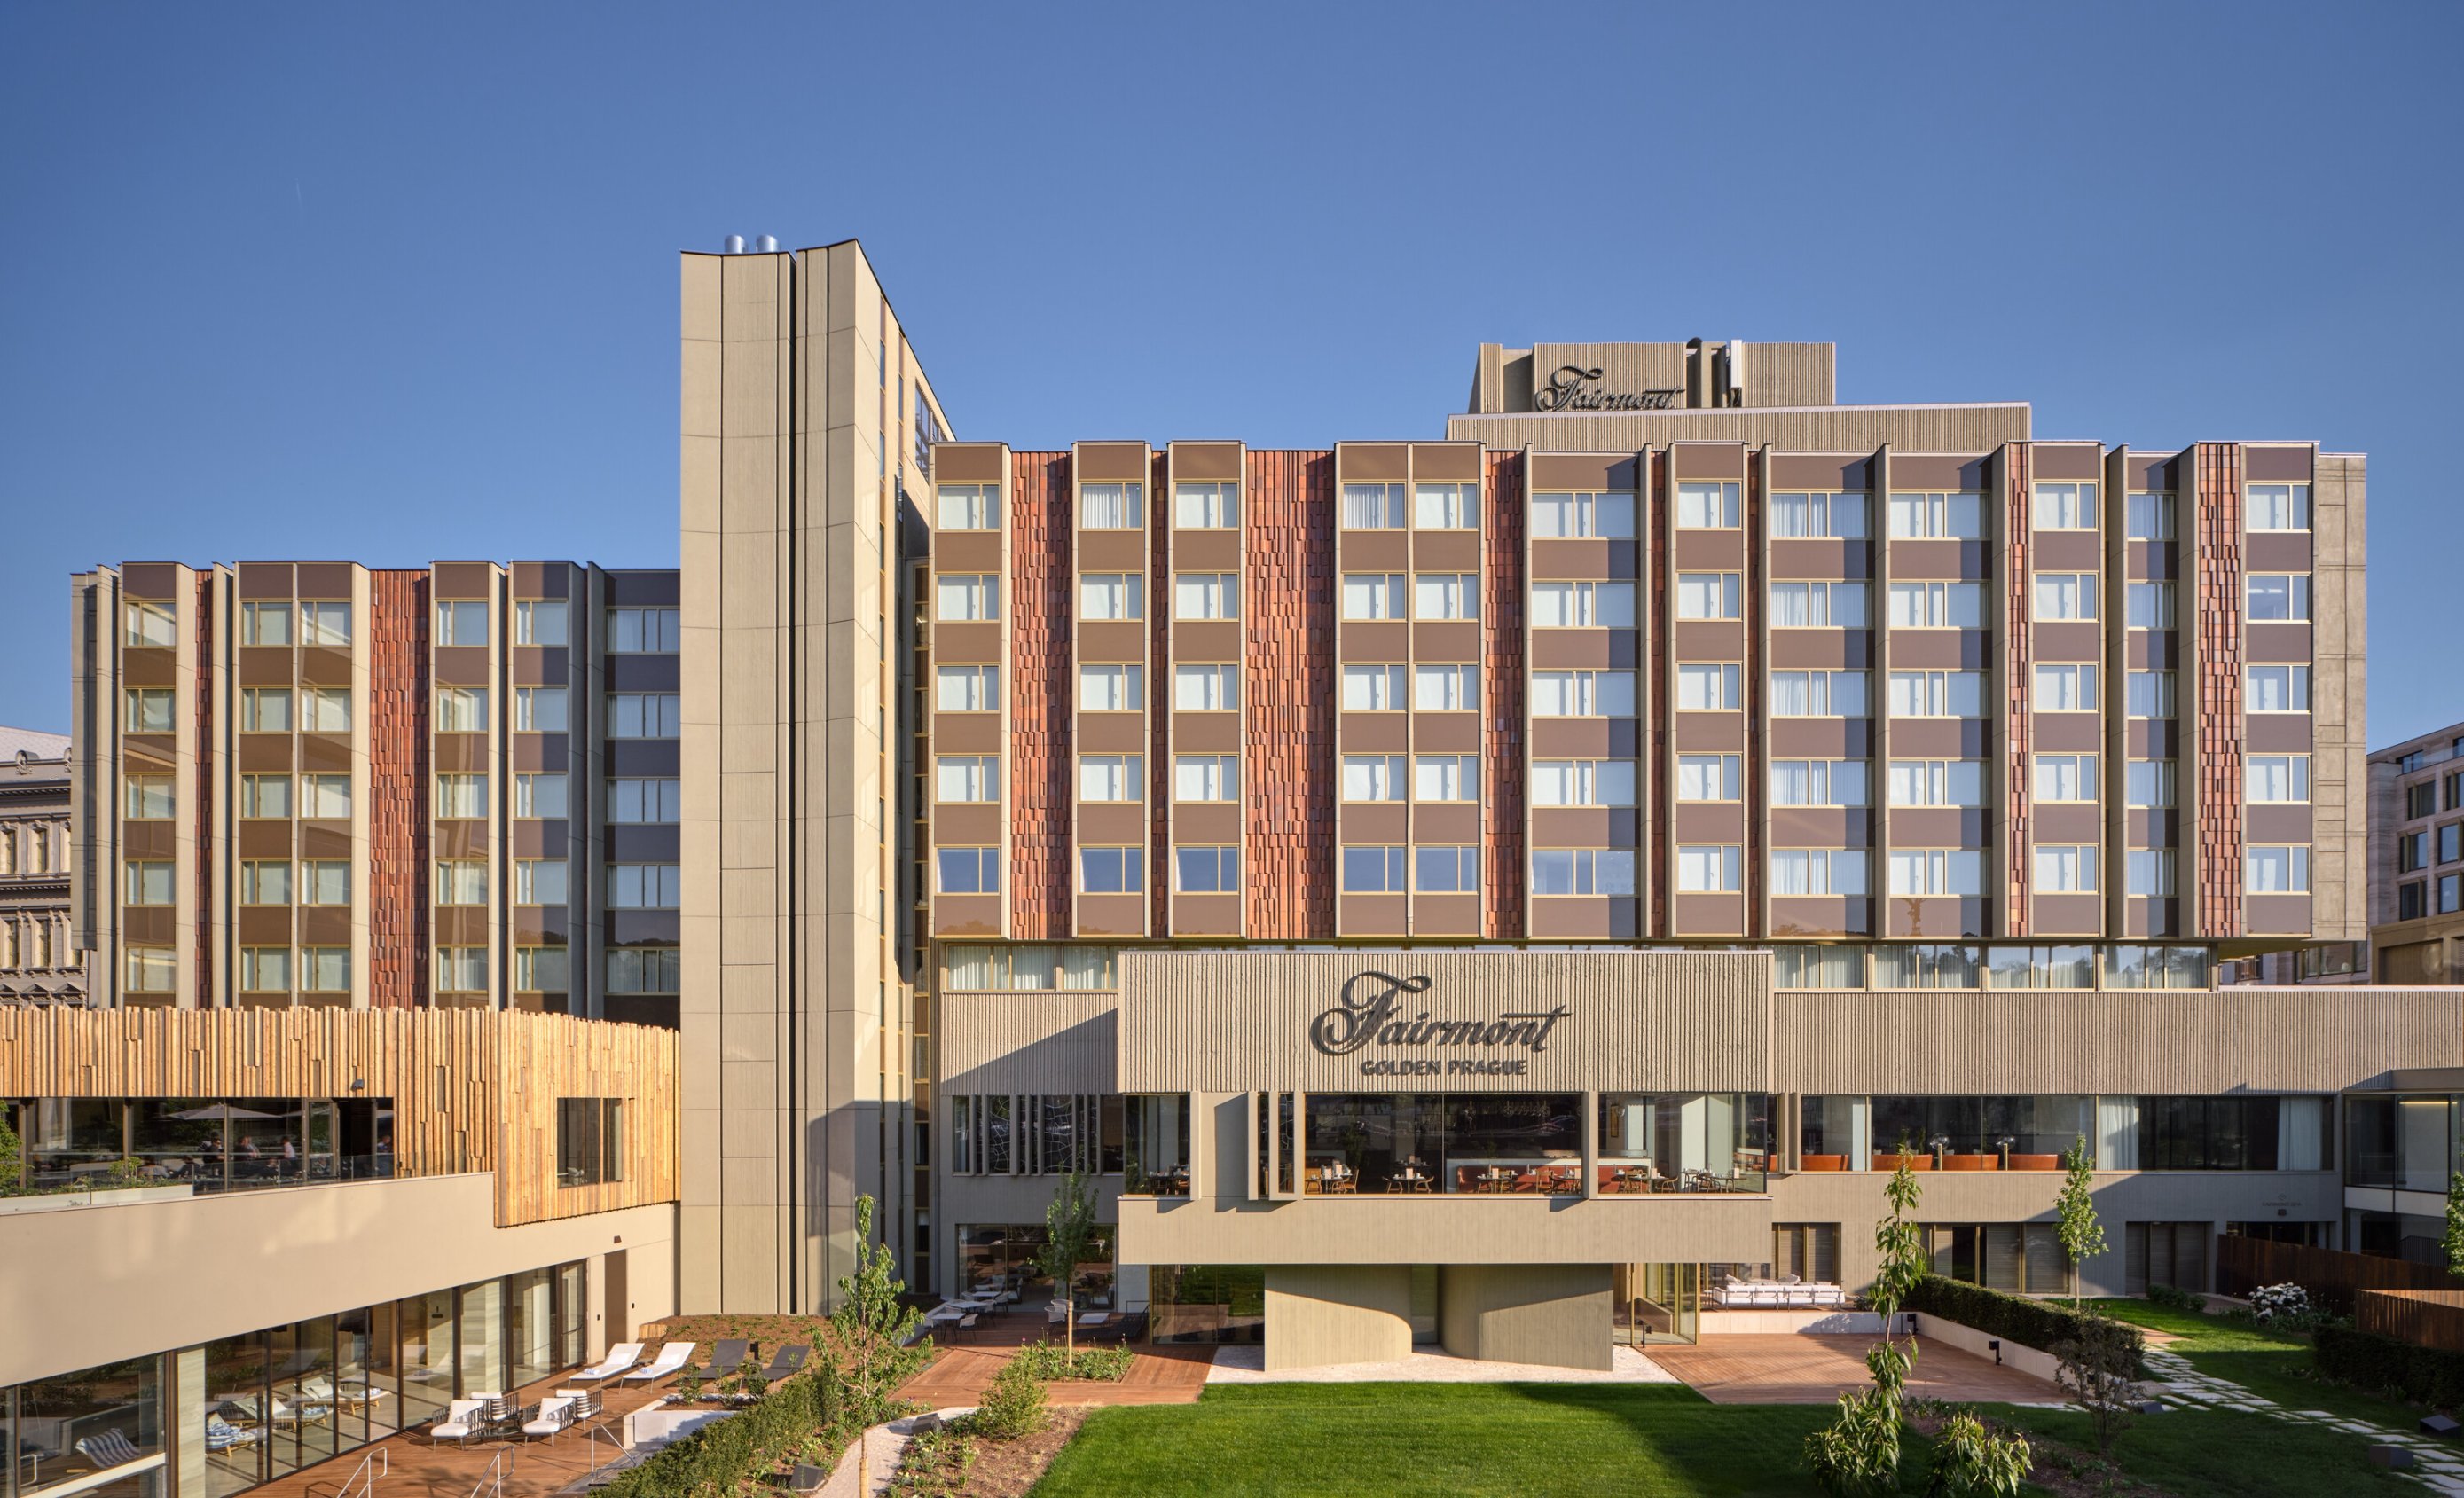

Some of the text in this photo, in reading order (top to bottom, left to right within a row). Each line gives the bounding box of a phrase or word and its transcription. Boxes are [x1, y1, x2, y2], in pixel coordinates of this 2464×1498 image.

[1536, 365, 1685, 412] Fairmont
[1310, 971, 1573, 1055] Fairmont
[1361, 1060, 1527, 1076] GOLDEN PRAGUE
